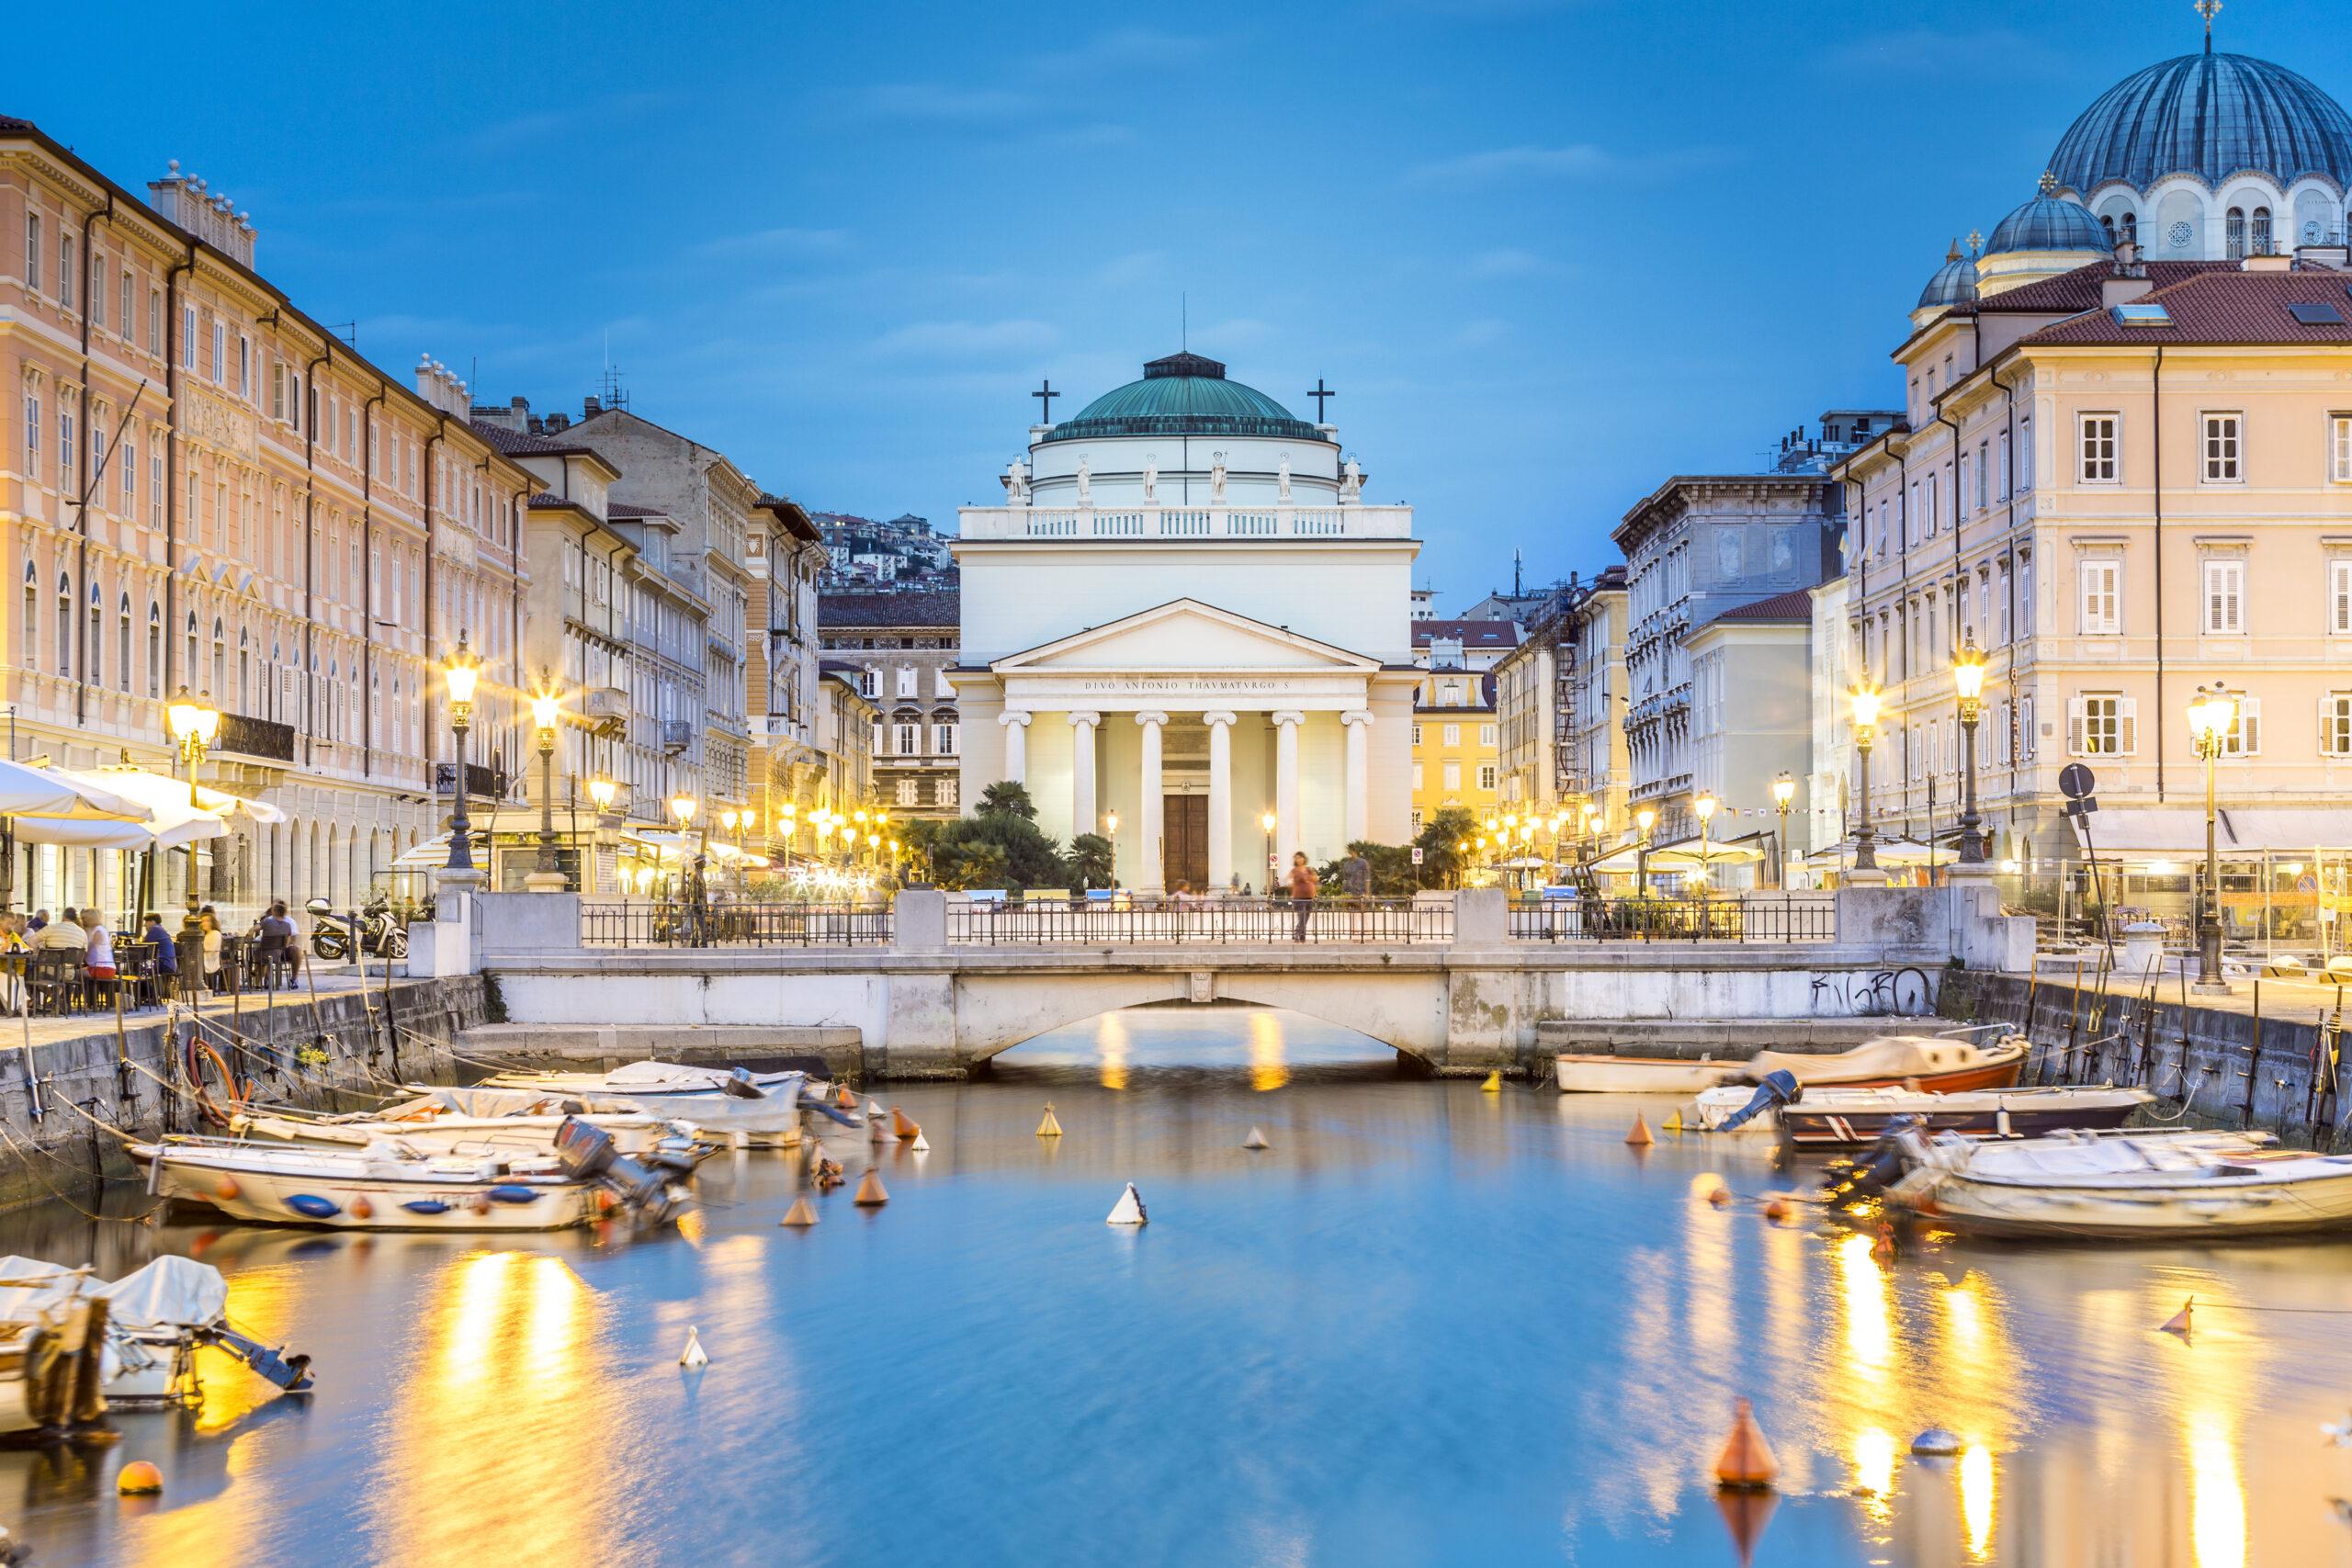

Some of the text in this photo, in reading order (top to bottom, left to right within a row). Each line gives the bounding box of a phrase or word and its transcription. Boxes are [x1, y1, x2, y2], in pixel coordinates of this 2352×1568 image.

[1085, 682, 1115, 690] DIVO
[1125, 682, 1178, 690] ANTONIO
[1188, 682, 1275, 690] THAVMATVRGO
